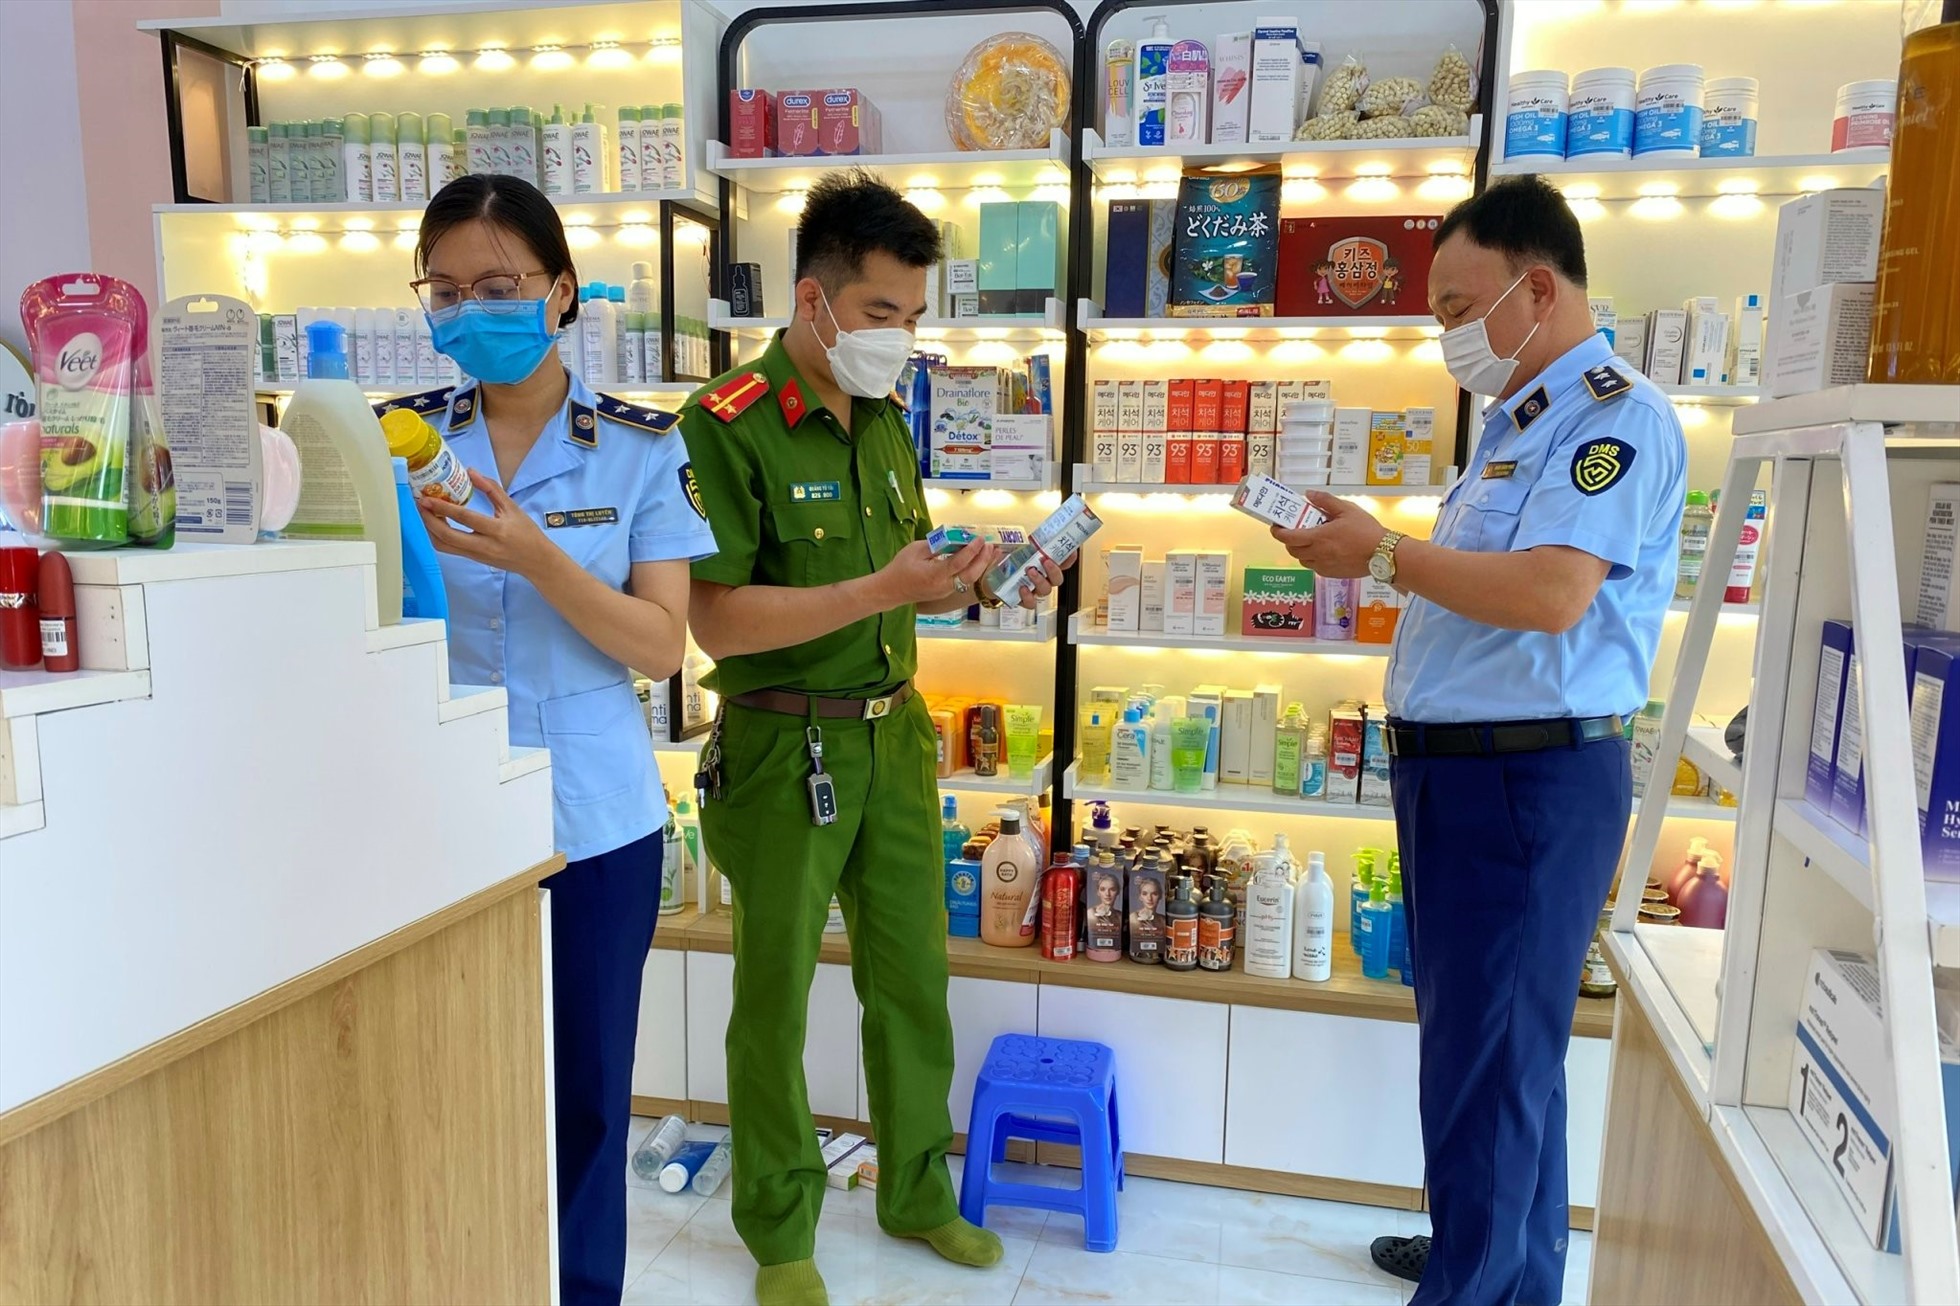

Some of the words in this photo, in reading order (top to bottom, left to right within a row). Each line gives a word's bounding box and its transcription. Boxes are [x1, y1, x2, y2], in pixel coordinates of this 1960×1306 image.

[1109, 80, 1129, 88] LOUV
[1154, 82, 1166, 90] Ive
[1108, 87, 1128, 96] CELL
[786, 97, 808, 105] durex
[826, 95, 848, 104] durex
[1186, 212, 1269, 238] どくだみ茶
[1343, 248, 1372, 261] 키즈
[1335, 261, 1379, 280] 홍삼정
[60, 350, 98, 372] Veet
[936, 387, 991, 398] Drainaflore
[1098, 408, 1114, 418] 치석
[1123, 408, 1139, 418] 치석
[1148, 408, 1164, 418] 치석
[1172, 408, 1189, 417] 치석
[1199, 408, 1216, 417] 치석
[1224, 408, 1241, 417] 치석
[1254, 408, 1271, 418] 치석
[948, 431, 978, 441] Détox
[1589, 444, 1620, 456] DMS
[1272, 495, 1291, 520] 치석
[1057, 536, 1076, 552] 치석
[1262, 575, 1274, 583] ECO
[1276, 575, 1295, 583] EARTH
[687, 692, 700, 703] nti
[652, 704, 667, 716] nti
[1011, 714, 1035, 724] Simple
[1178, 727, 1204, 737] Simple
[1278, 739, 1298, 749] Simple
[990, 890, 1024, 902] Natural
[1256, 895, 1280, 903] Eucerin
[1800, 1062, 1809, 1117] 1
[1832, 1112, 1849, 1179] 2
